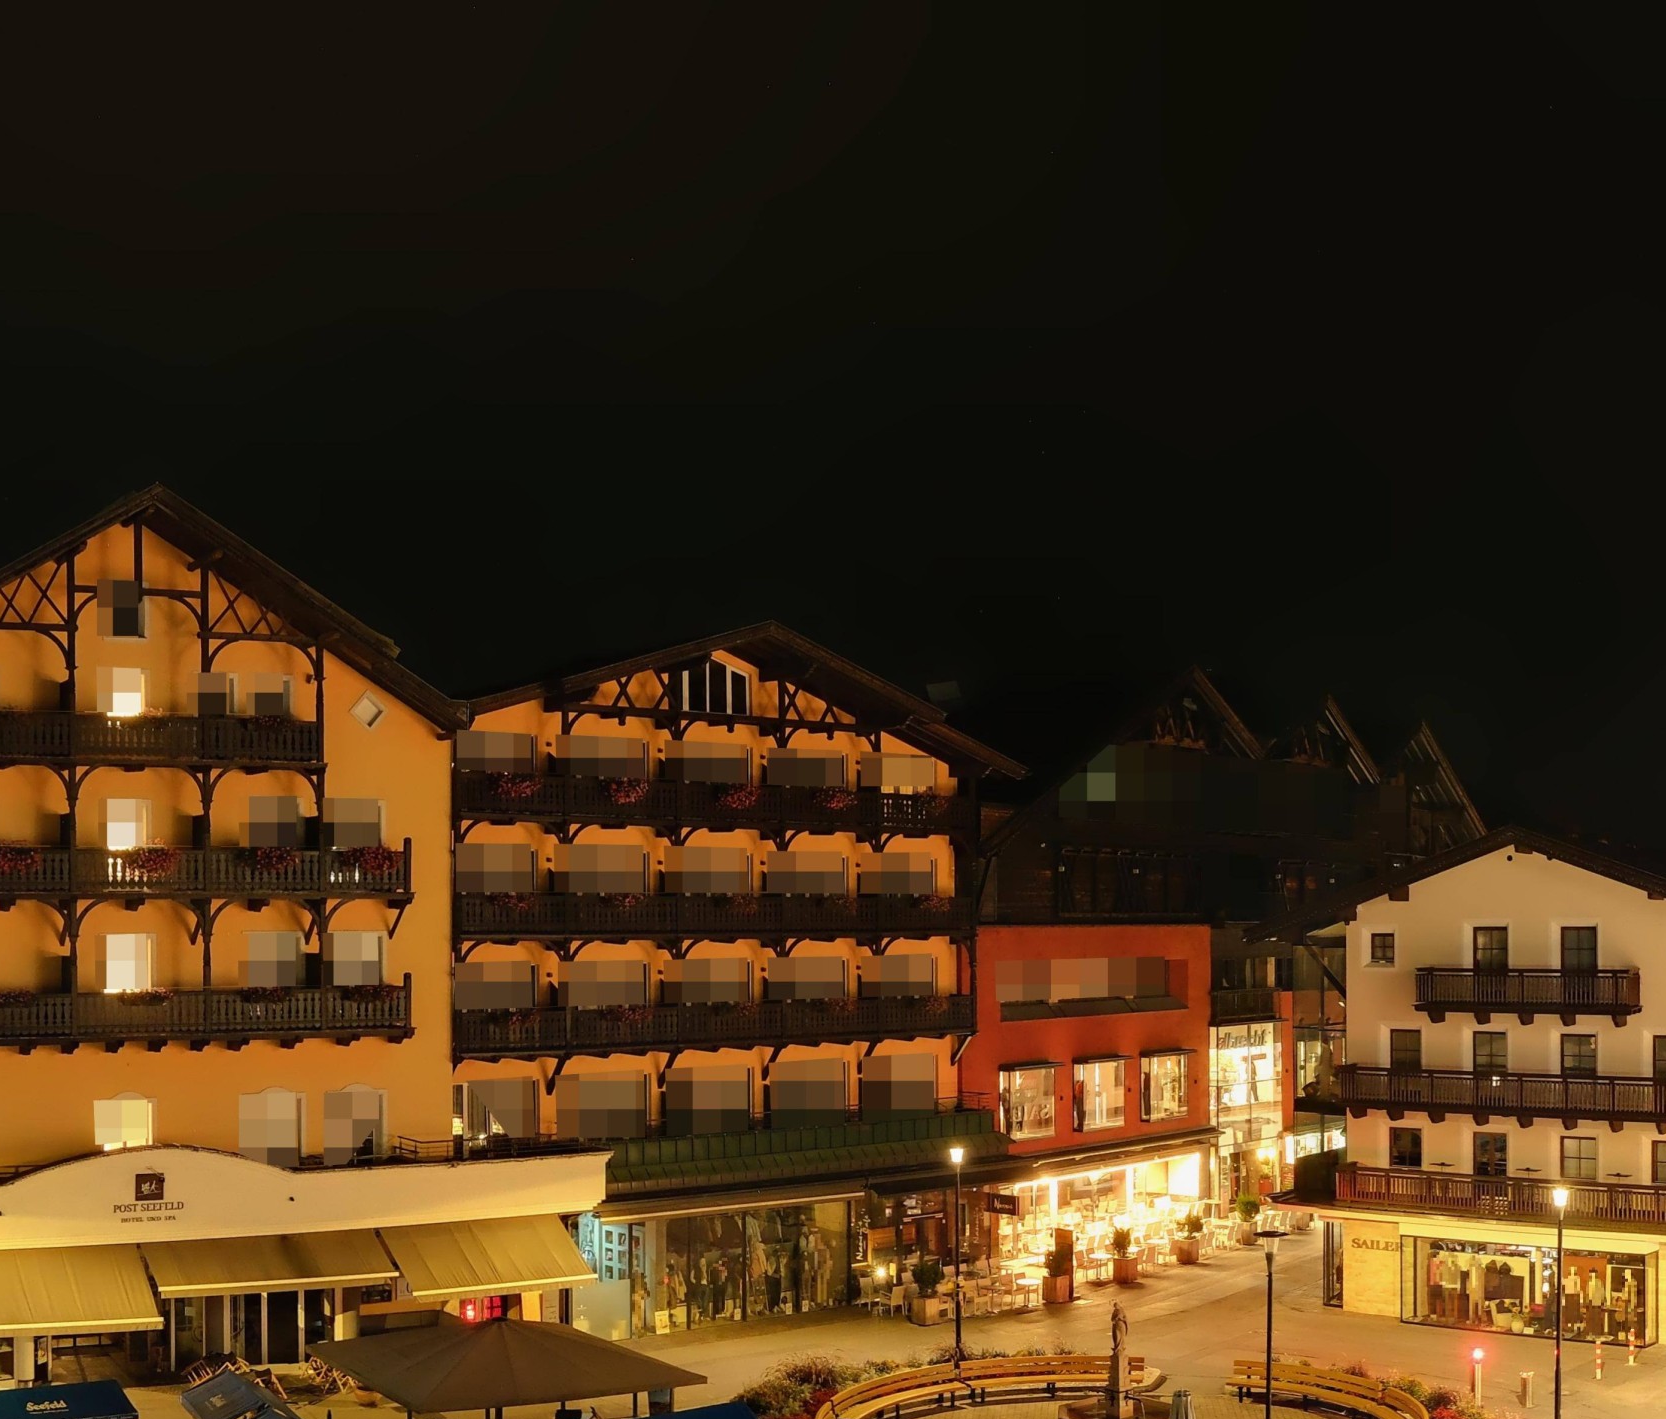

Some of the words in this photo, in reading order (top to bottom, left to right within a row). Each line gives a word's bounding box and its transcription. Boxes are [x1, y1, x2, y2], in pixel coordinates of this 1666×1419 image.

[113, 1204, 138, 1213] POST
[141, 1202, 184, 1212] SEEFELD
[26, 1400, 67, 1412] Seefeld
